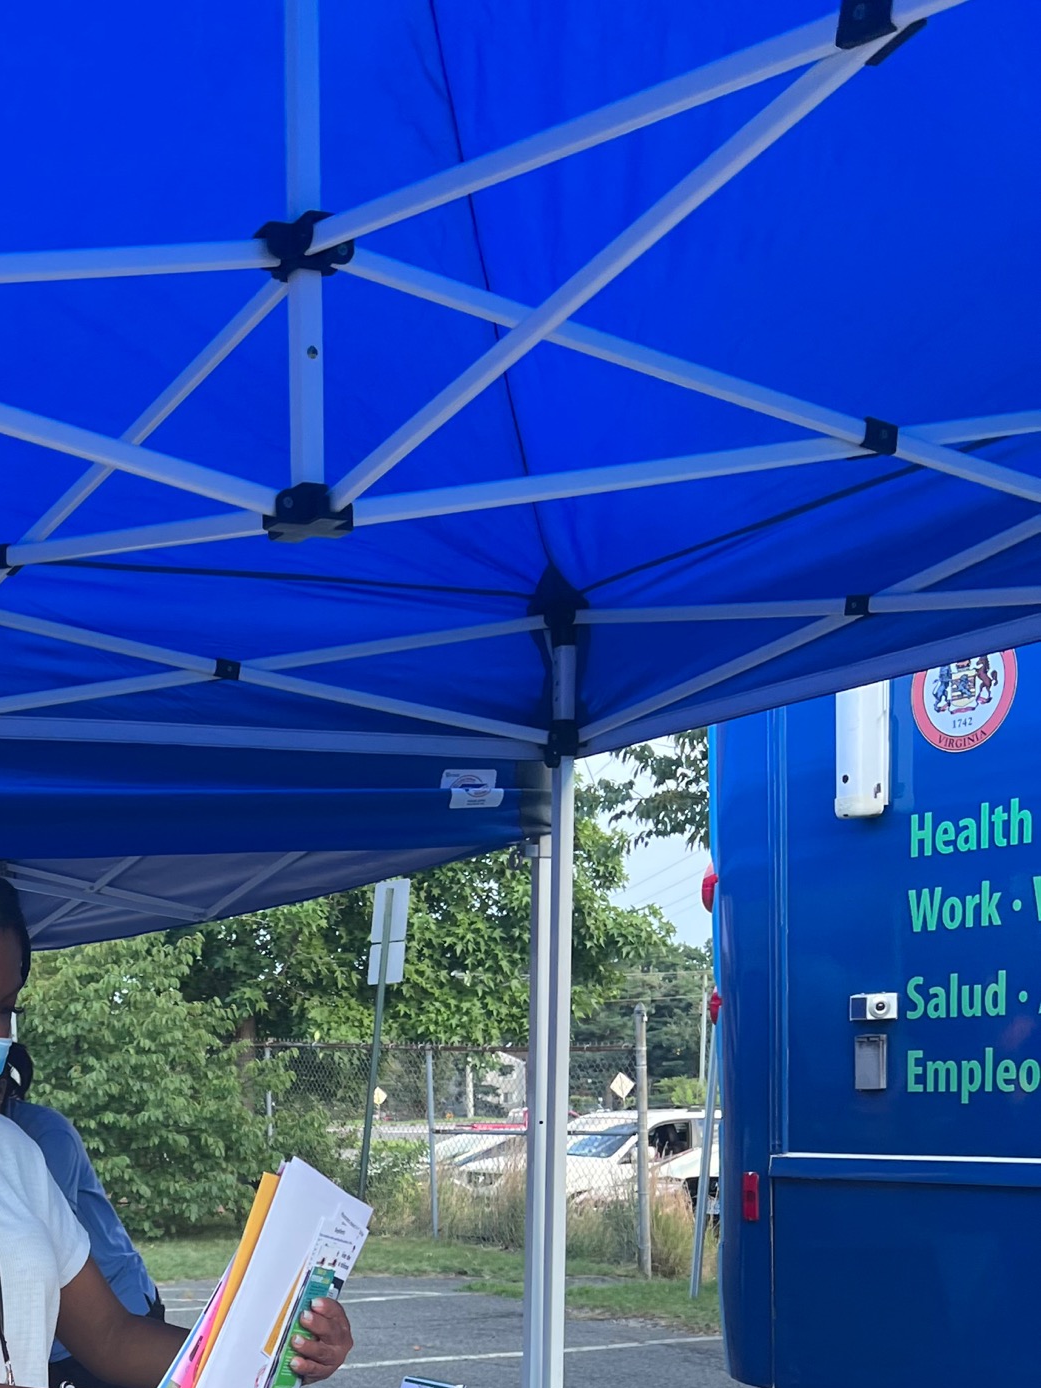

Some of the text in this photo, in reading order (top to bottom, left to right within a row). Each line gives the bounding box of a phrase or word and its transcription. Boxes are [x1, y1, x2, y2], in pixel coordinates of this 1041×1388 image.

[938, 729, 987, 749] VIRGINIA
[952, 717, 973, 729] 1742
[910, 797, 1033, 858] Health
[908, 881, 1002, 933] Work
[906, 970, 1006, 1020] Salud
[906, 1047, 1041, 1104] Empleo
